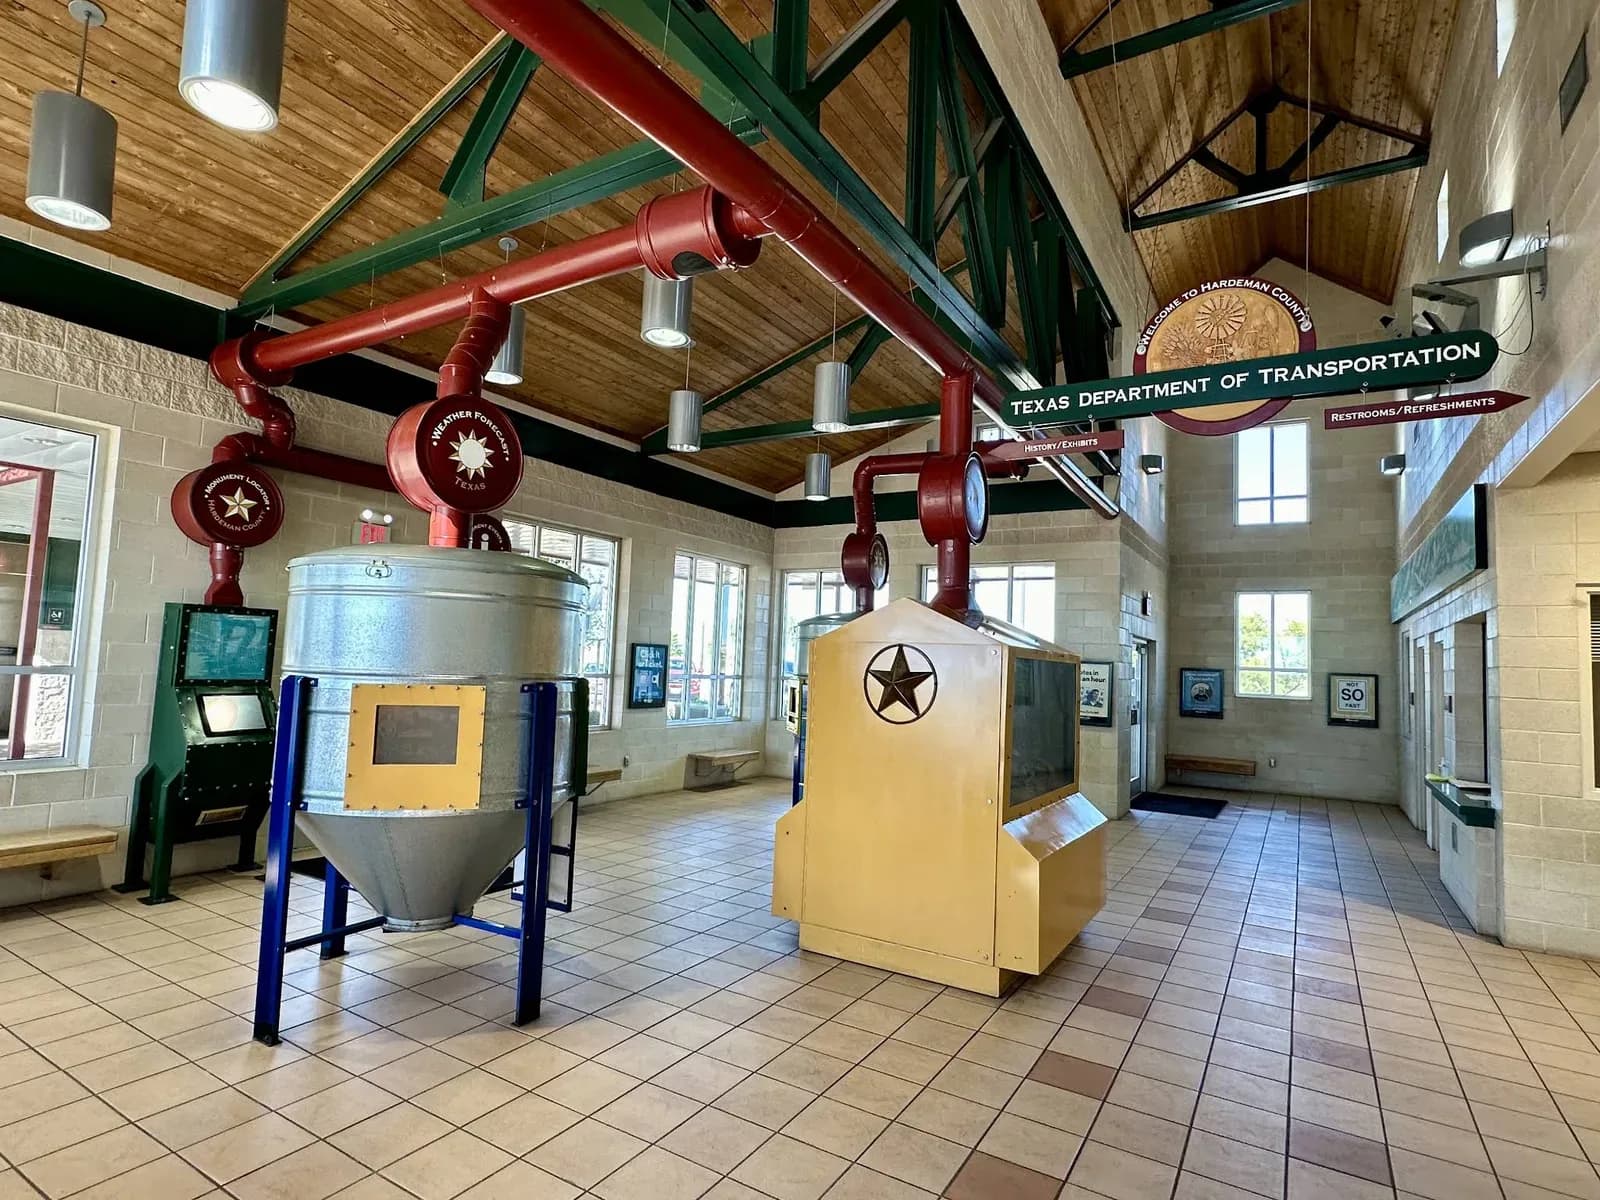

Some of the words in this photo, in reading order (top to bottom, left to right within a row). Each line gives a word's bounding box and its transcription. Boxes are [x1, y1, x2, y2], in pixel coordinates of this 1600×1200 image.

[1141, 297, 1182, 345] WELCOME
[1182, 288, 1198, 301] TO
[1200, 279, 1271, 293] HARDEMAN
[1271, 287, 1307, 323] COUNTY
[1010, 395, 1070, 415] TEXAS
[1079, 377, 1211, 408] DEPARTMENT
[1220, 372, 1250, 389] OF
[1259, 342, 1481, 384] TRANSPORTATION
[1331, 397, 1496, 422] RESTROOMS/REFRESHMENTS
[431, 410, 472, 440] WEATHER
[474, 411, 510, 455] FORECAST
[1024, 438, 1098, 452] HISTORY/EXHIBITS
[204, 474, 246, 494] MONUMENT
[246, 477, 270, 505] LOCATOR
[455, 476, 486, 490] TEXAS
[208, 500, 241, 531] HARDEMAN
[242, 511, 266, 531] COUNTY
[1341, 688, 1364, 701] SO
